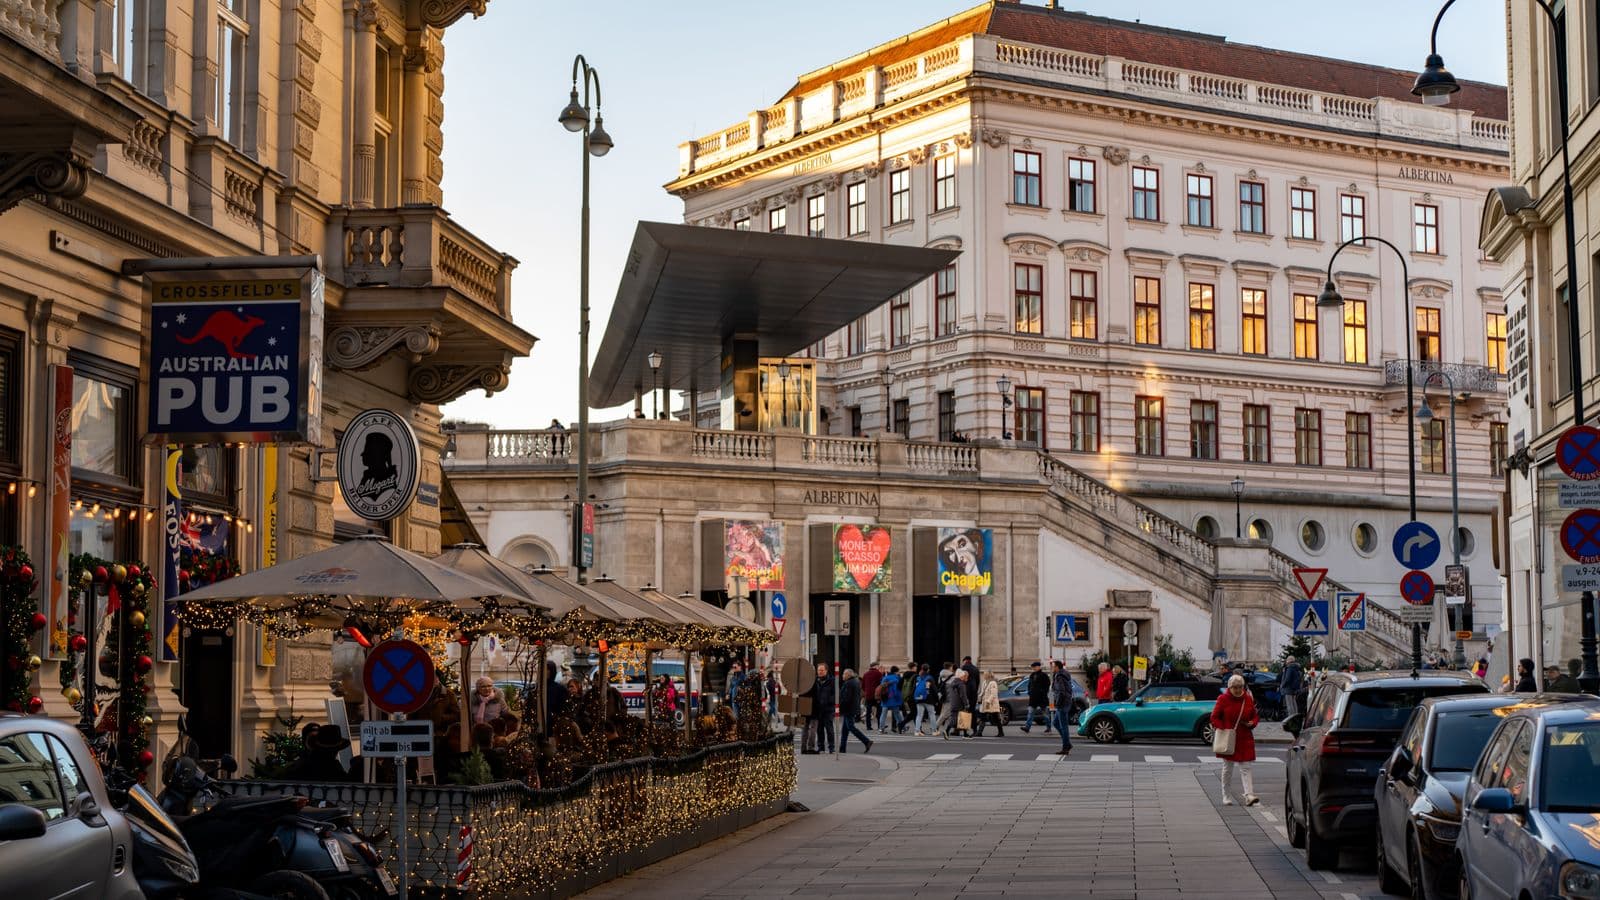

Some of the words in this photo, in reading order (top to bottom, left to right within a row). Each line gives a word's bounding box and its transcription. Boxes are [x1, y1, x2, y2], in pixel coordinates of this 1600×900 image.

[792, 152, 833, 177] ALBERTINA
[1398, 166, 1454, 185] ALBERTINA
[160, 283, 293, 299] CROSSFIELD'S
[159, 354, 289, 373] AUSTRALIAN
[157, 375, 290, 425] PUB
[357, 474, 397, 495] Mozart
[349, 488, 361, 506] BEI
[360, 504, 378, 513] DER
[381, 488, 403, 511] OPER
[803, 489, 879, 506] ALBERTINA
[838, 540, 874, 551] MONET
[838, 551, 881, 562] PICASSO
[844, 562, 860, 574] JIM
[862, 563, 884, 574] DINE
[941, 571, 991, 591] Chagall
[1567, 579, 1599, 589] ausgen.
[1352, 610, 1361, 619] 20
[399, 741, 411, 752] bis
